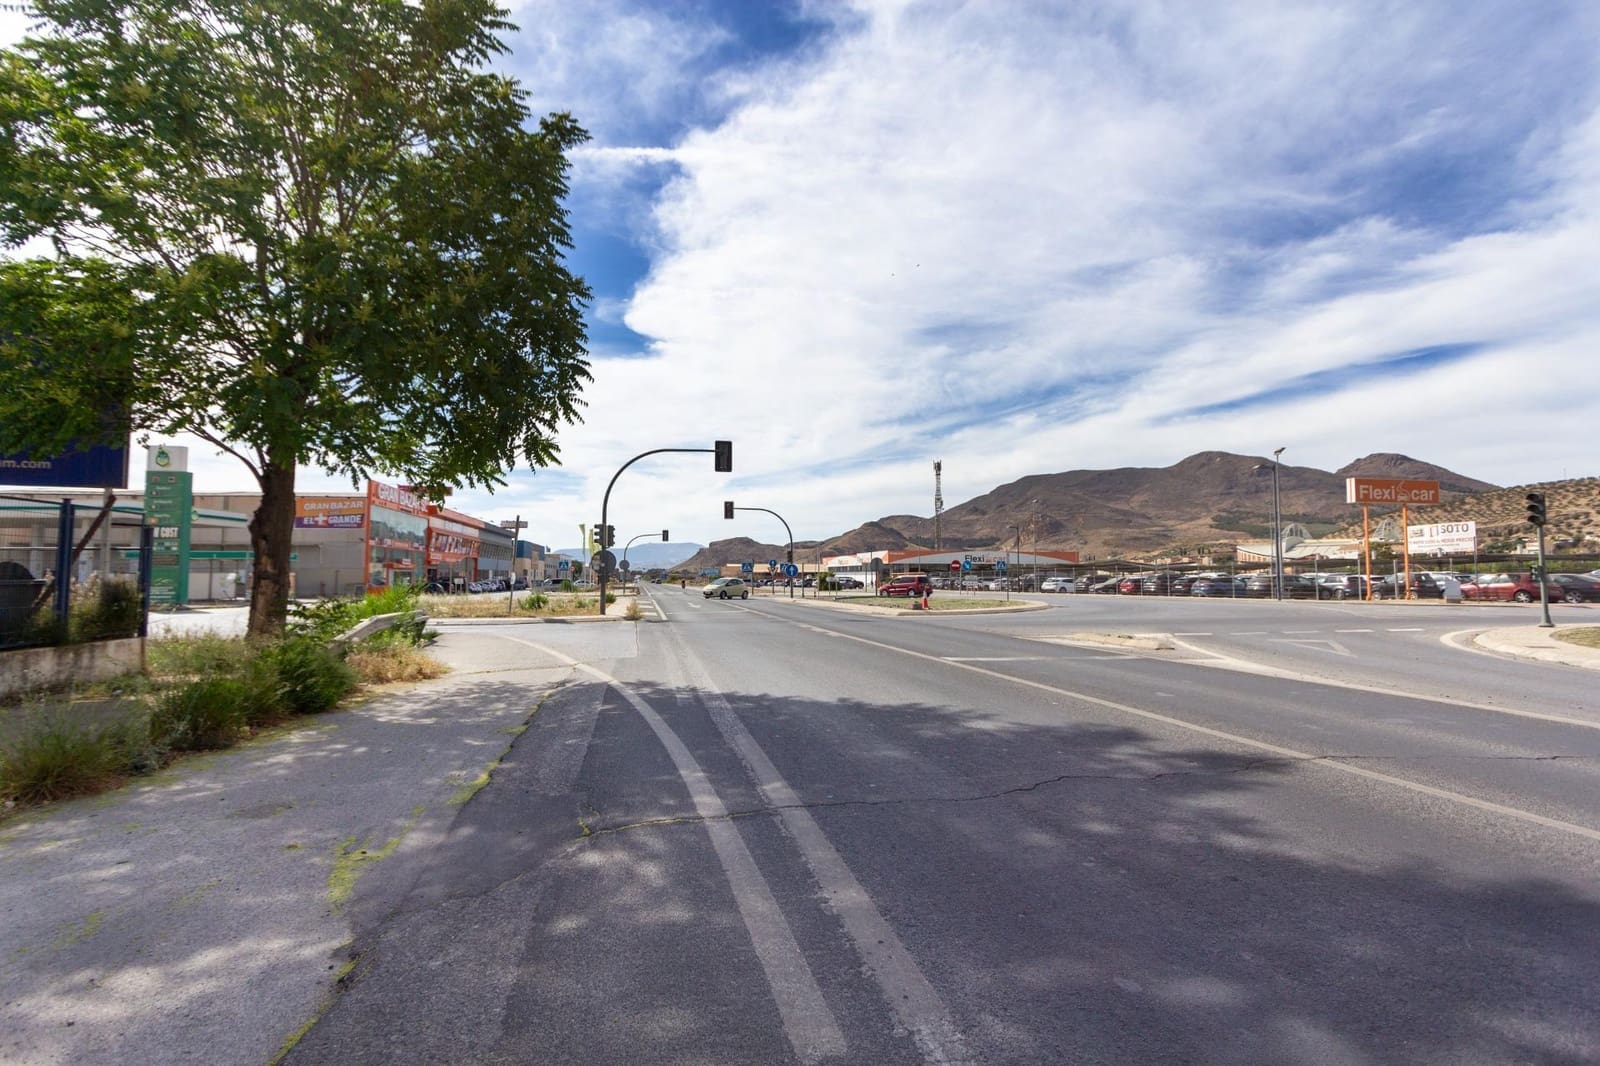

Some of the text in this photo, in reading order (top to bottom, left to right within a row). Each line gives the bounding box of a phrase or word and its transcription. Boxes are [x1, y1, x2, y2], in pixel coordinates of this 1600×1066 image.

[1360, 485, 1435, 500] Flexi car
[304, 501, 363, 510] GRAN BAZAR
[328, 515, 362, 524] GRANDE
[1441, 523, 1469, 533] SOTO
